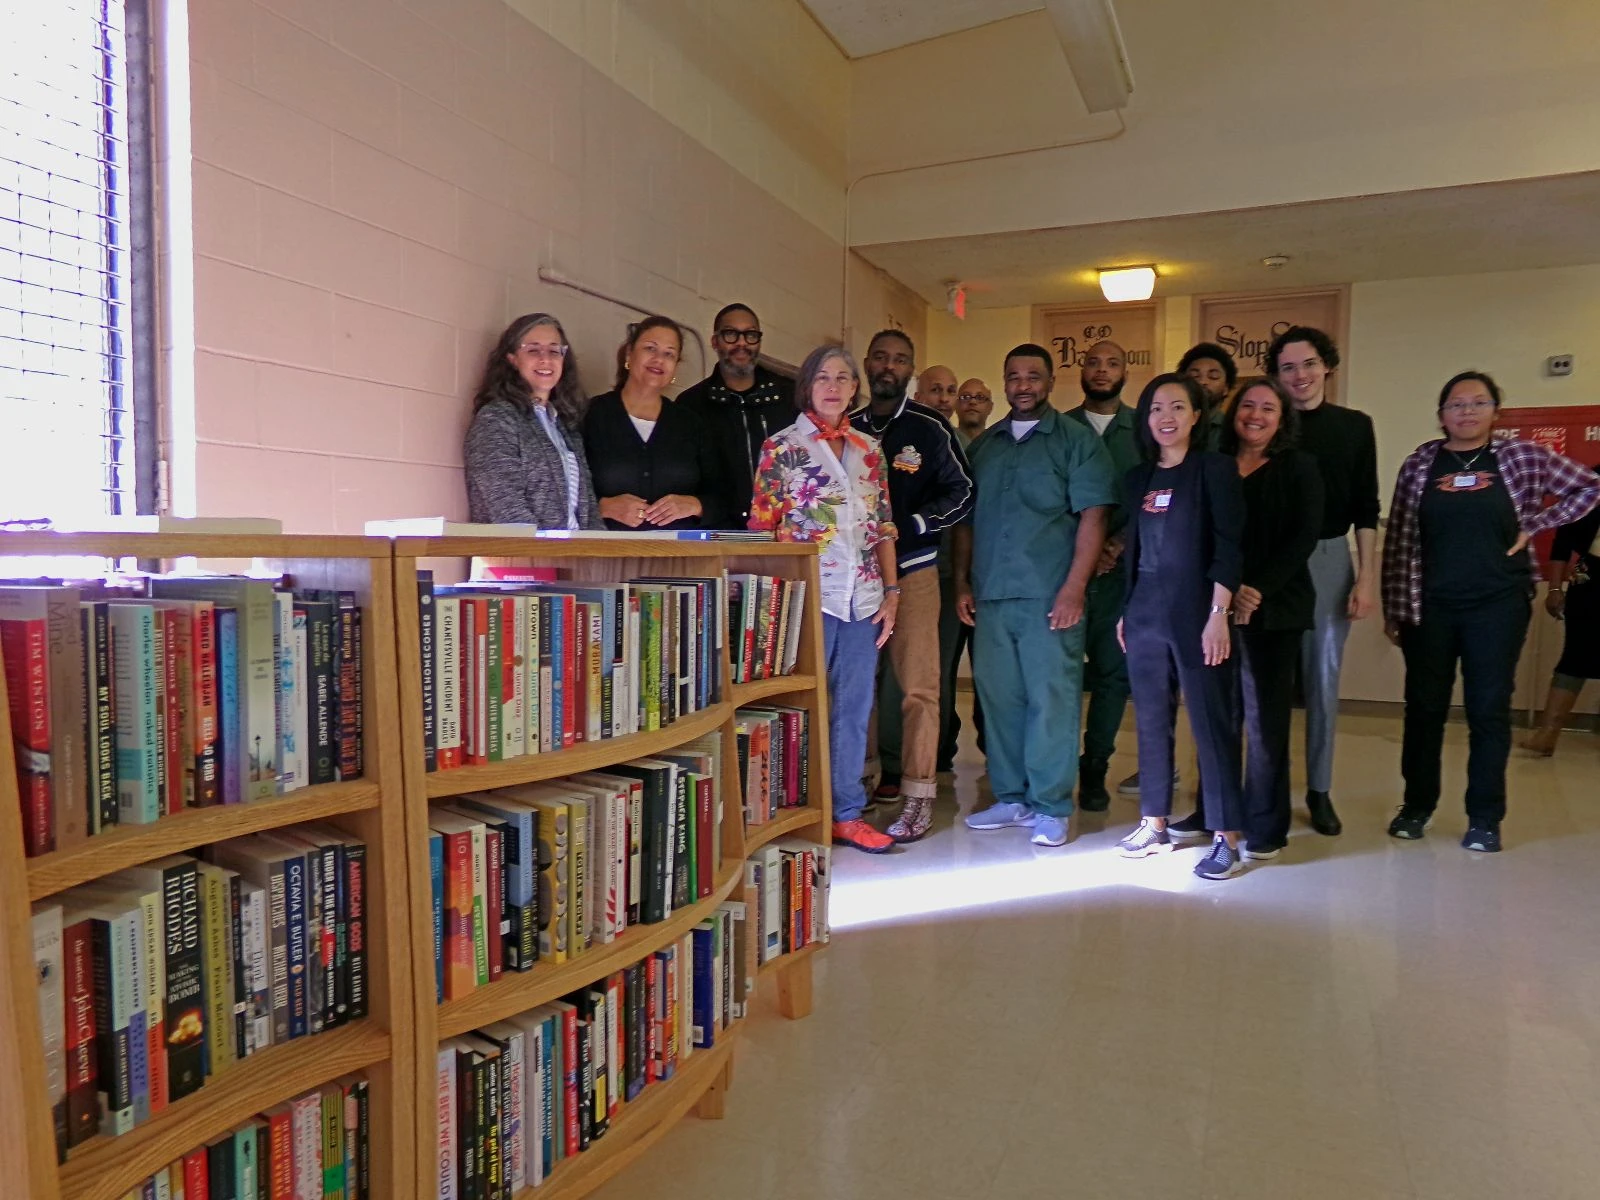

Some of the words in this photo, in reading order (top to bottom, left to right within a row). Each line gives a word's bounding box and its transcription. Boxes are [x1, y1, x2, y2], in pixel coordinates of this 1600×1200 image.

[48, 602, 65, 655] Mine
[143, 615, 152, 655] charles
[168, 621, 176, 650] ANNIE
[200, 610, 209, 649] CROOKED
[314, 620, 322, 631] los
[322, 624, 330, 633] La
[530, 603, 539, 640] Drown
[31, 631, 43, 659] TIM
[273, 633, 281, 648] THE
[444, 616, 452, 674] CHANEYSVILLE
[592, 614, 600, 674] MURAKAMI
[322, 652, 330, 662] de
[423, 614, 432, 711] LATEHOMECOMER
[98, 686, 109, 703] MY
[144, 658, 153, 705] wheelan
[201, 653, 211, 707] HALLELUJAH
[316, 674, 327, 704] ISABEL
[444, 677, 453, 712] INCIDENT
[32, 662, 44, 730] WINTON
[490, 696, 498, 722] JAVIER
[98, 705, 109, 733] SOUL
[145, 712, 154, 745] naked
[318, 706, 328, 746] ALLENDE
[424, 716, 432, 736] THE
[100, 735, 111, 769] LOOKS
[204, 744, 214, 755] JO
[770, 737, 778, 792] WOMAN
[146, 750, 155, 795] statistics
[204, 759, 214, 782] FORD
[101, 772, 112, 801] BACK
[678, 776, 686, 822] STEPHEN
[678, 824, 686, 854] KING
[324, 850, 334, 882] TENDER
[575, 852, 584, 893] TOBIAS
[210, 879, 219, 924] Angela's
[271, 874, 286, 928] DISPATCHES
[290, 865, 302, 912] OCTAVIA
[325, 883, 334, 892] IS
[325, 892, 335, 909] THE
[350, 860, 361, 918] AMERICAN
[166, 876, 182, 956] RHODES
[181, 871, 198, 948] RICHARD
[290, 914, 302, 924] E.
[326, 910, 336, 935] FLESH
[474, 905, 482, 927] MAN
[75, 939, 84, 954] the
[148, 928, 156, 955] EDGAR
[212, 928, 220, 959] Ashes
[292, 925, 302, 962] BUTLER
[350, 921, 362, 952] GODS
[75, 954, 84, 982] stories
[252, 948, 264, 982] Think
[273, 944, 287, 985] MICHAEL
[326, 942, 334, 970] AGUSTINA
[352, 957, 361, 973] NEIL
[475, 929, 486, 976] INVISIBLE
[76, 984, 85, 994] of
[148, 958, 157, 996] WIDEMAN
[214, 966, 222, 998] Frank
[352, 976, 361, 1003] GAIMAN
[71, 994, 91, 1025] John
[274, 984, 288, 1010] HERR
[216, 1002, 224, 1048] McCourt
[76, 1025, 92, 1084] Cheever
[440, 1068, 450, 1094] THE
[504, 1081, 510, 1089] OF
[512, 1062, 522, 1120] Hopscotch
[440, 1095, 450, 1126] BEST
[440, 1127, 450, 1146] WE
[488, 1138, 498, 1153] gods
[440, 1150, 450, 1194] COULD
[488, 1154, 498, 1162] of
[488, 1163, 498, 1184] tango
[284, 1186, 290, 1194] OF
